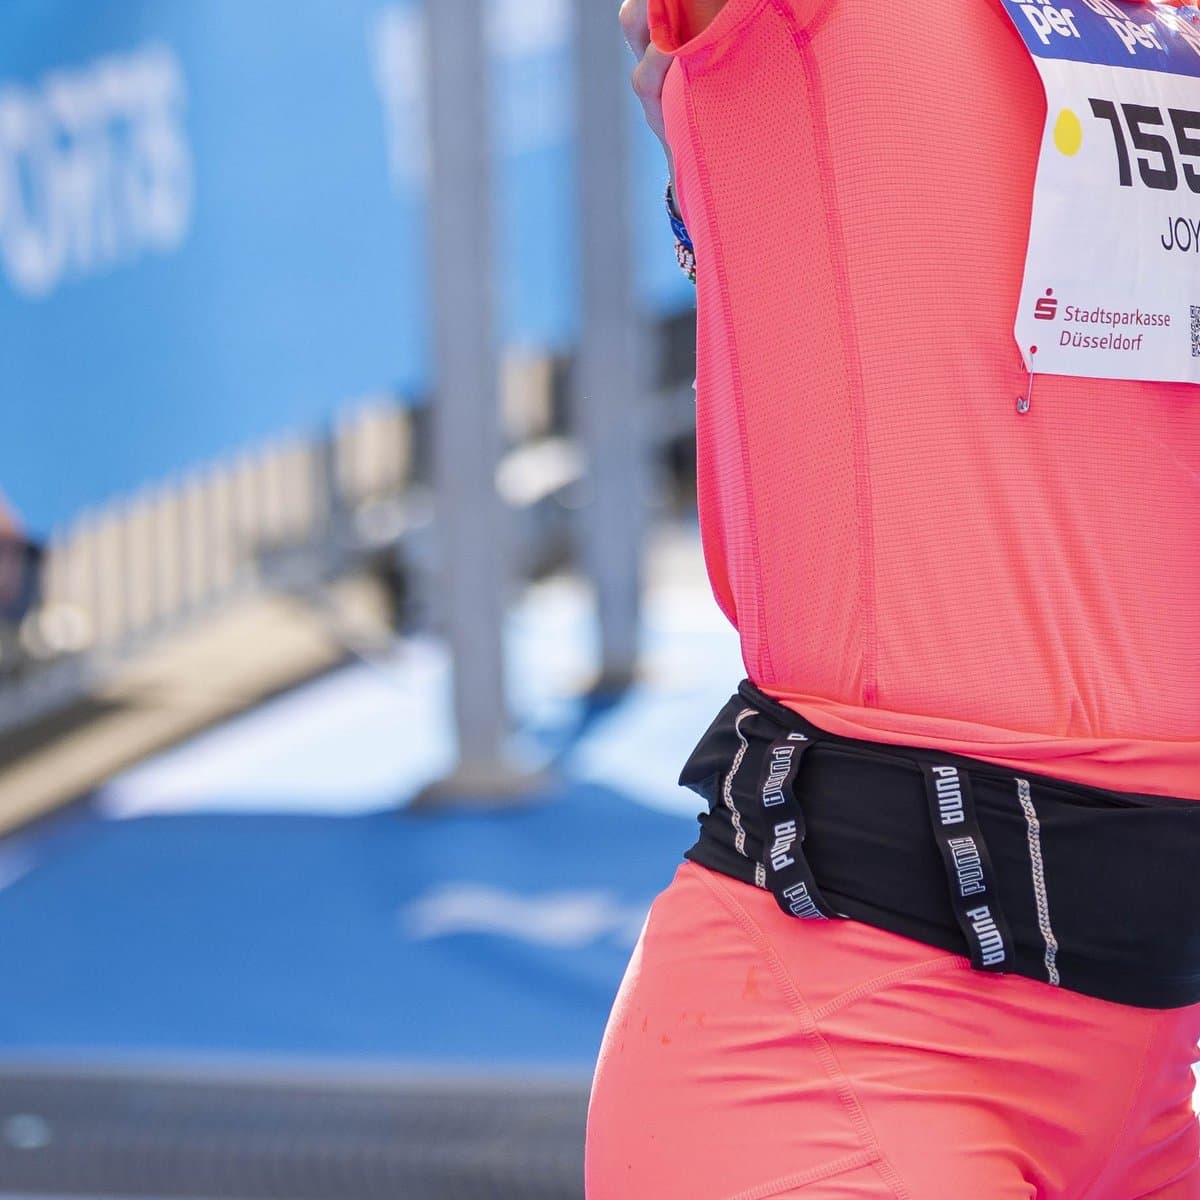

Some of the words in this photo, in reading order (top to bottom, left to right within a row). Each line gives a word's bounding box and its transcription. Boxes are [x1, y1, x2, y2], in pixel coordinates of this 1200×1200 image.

[1019, 3, 1081, 45] per
[1105, 16, 1163, 55] per
[1060, 330, 1143, 351] Düsseldorf
[1063, 305, 1171, 328] Stadtsparkasse
[763, 746, 795, 807] PUMA
[932, 766, 965, 825] PUMA
[948, 836, 986, 896] PUMA
[784, 881, 829, 920] PU
[966, 905, 1006, 966] PUMA
